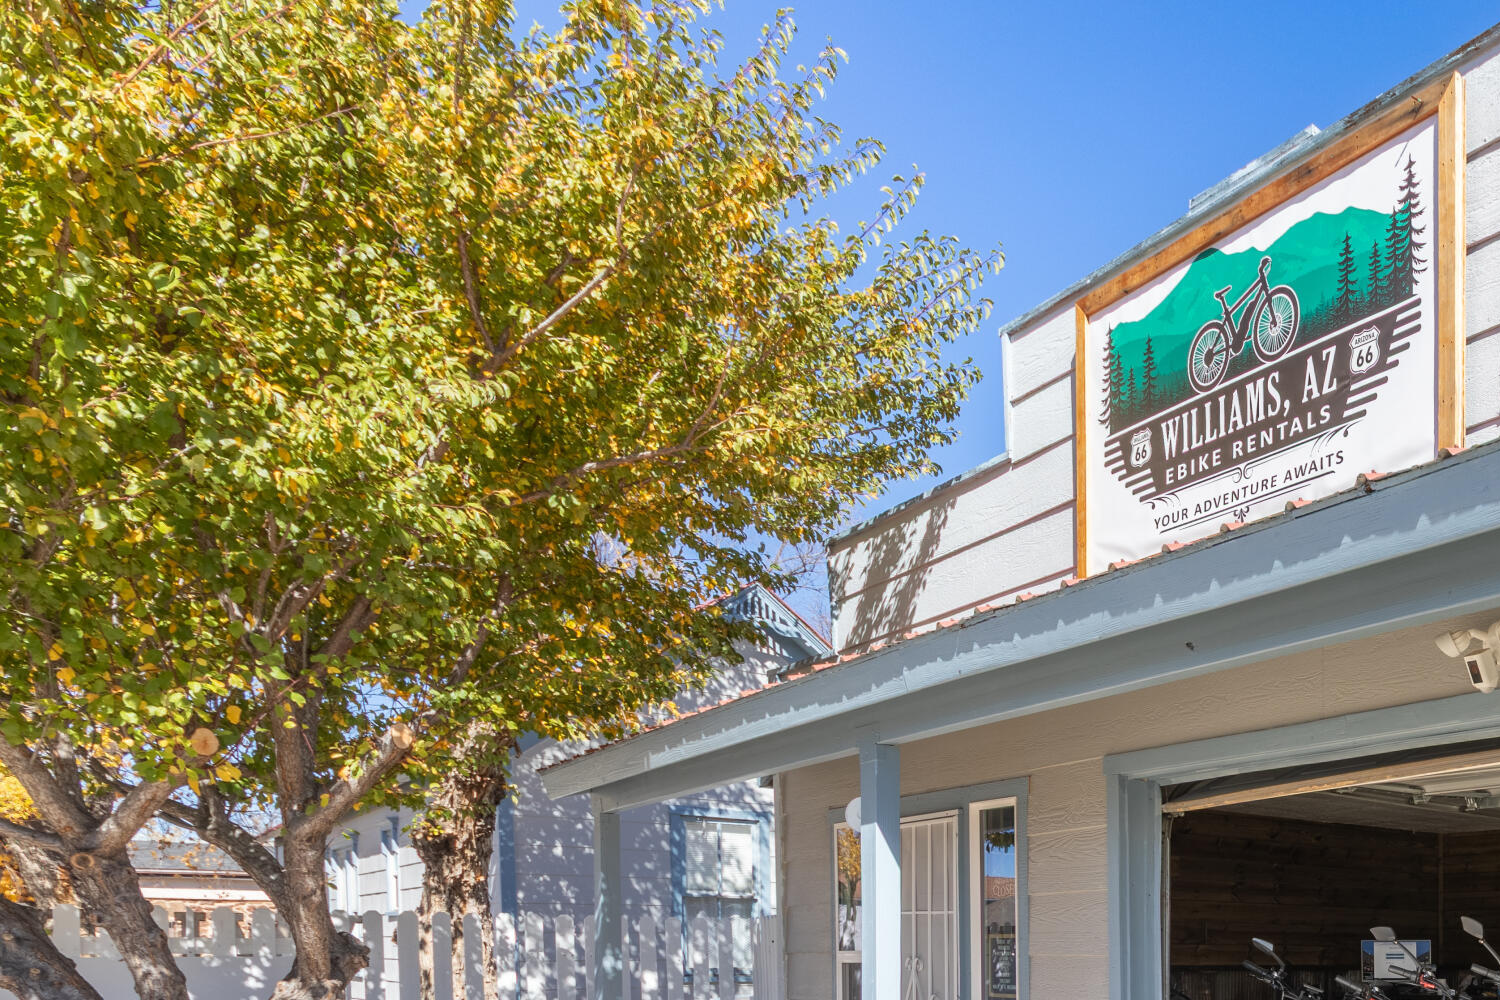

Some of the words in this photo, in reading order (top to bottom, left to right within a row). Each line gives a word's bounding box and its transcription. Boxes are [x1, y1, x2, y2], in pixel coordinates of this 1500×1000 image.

[1357, 345, 1373, 367] 66
[1161, 371, 1291, 461] WILLIAMS,
[1301, 345, 1338, 403] AZ
[1135, 444, 1147, 461] 66
[1166, 448, 1222, 485] EBIKE
[1232, 405, 1332, 459] RENTALS
[1154, 507, 1189, 529] YOUR
[1194, 474, 1278, 516] ADVENTURE
[1283, 450, 1344, 483] AWAITS
